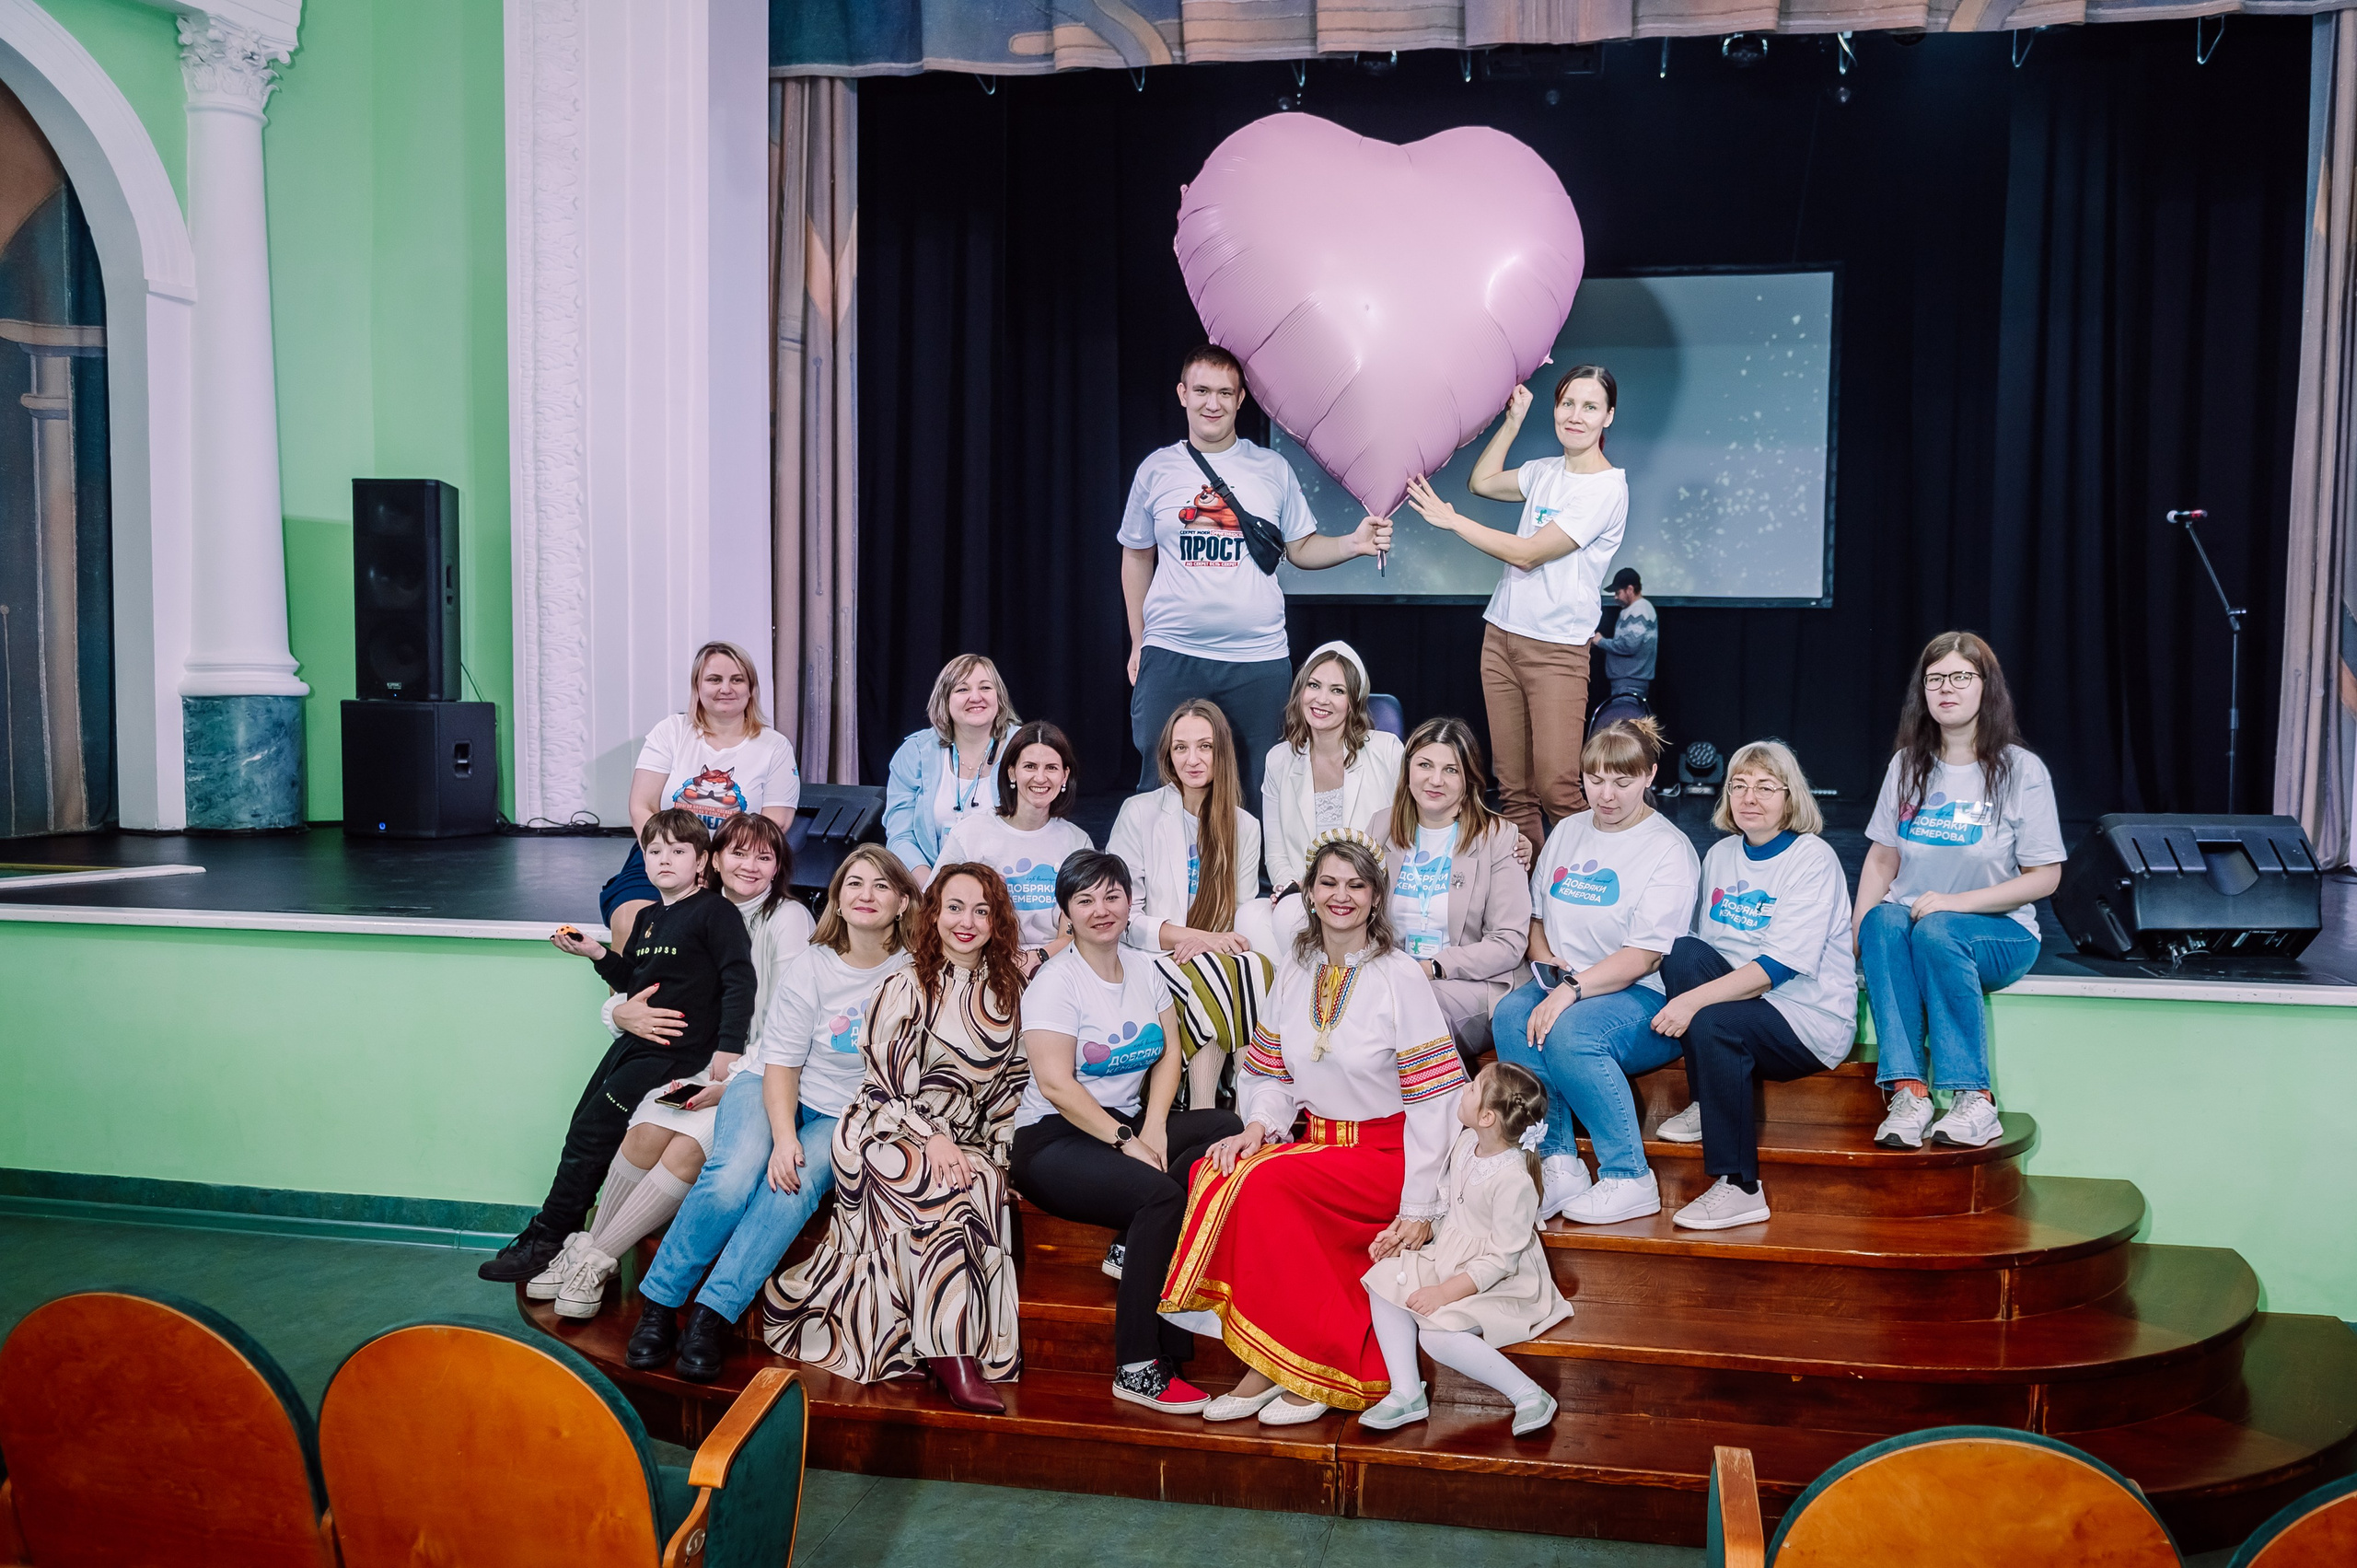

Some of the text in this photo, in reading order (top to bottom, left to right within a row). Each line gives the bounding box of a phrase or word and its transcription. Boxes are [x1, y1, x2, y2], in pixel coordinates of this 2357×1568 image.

[1179, 535, 1245, 561] ПРОСТ
[1911, 816, 1968, 832] ДОБРЯКИ
[1909, 827, 1966, 842] КЕМЕРОВА
[1007, 884, 1056, 894] ДОБРЯКИ
[1562, 877, 1608, 894] ДОБРЯКИ
[1012, 895, 1058, 903] ЕМЕРОВА
[1558, 887, 1601, 903] КЕМЕРОВА
[1108, 1046, 1164, 1068] ДОБРЯКИ
